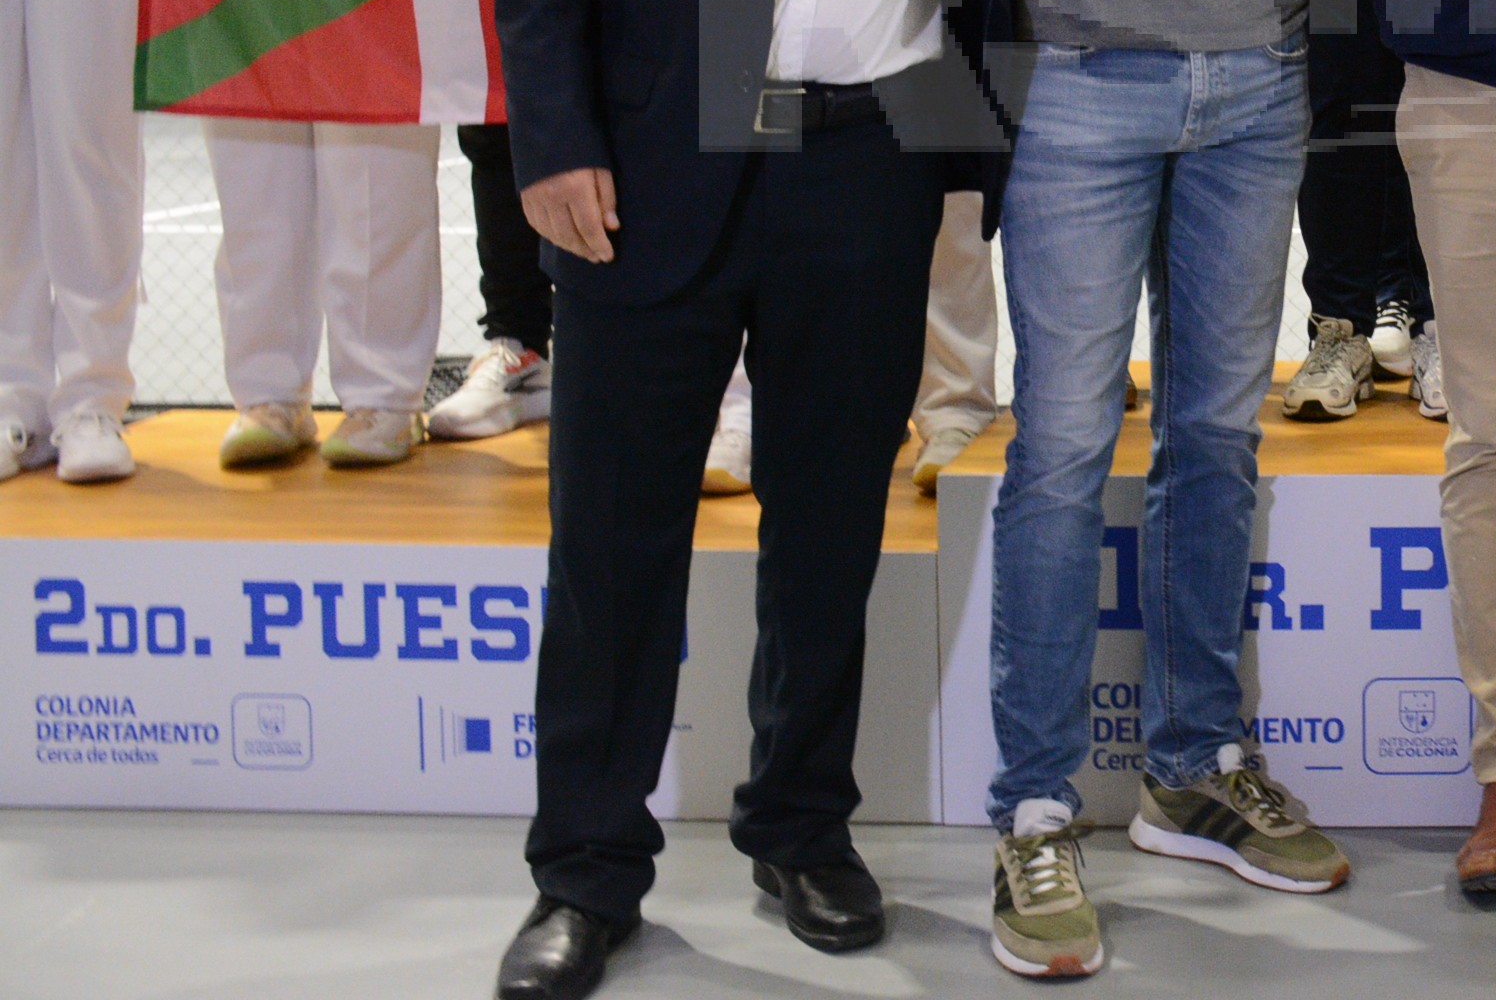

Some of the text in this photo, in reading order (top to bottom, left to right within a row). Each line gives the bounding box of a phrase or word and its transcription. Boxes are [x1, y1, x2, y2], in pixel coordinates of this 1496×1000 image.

[242, 581, 549, 661] PUES
[35, 694, 136, 717] COLONIA
[36, 720, 219, 744] DEPARTAMENTO
[36, 745, 159, 764] Cerca de todos
